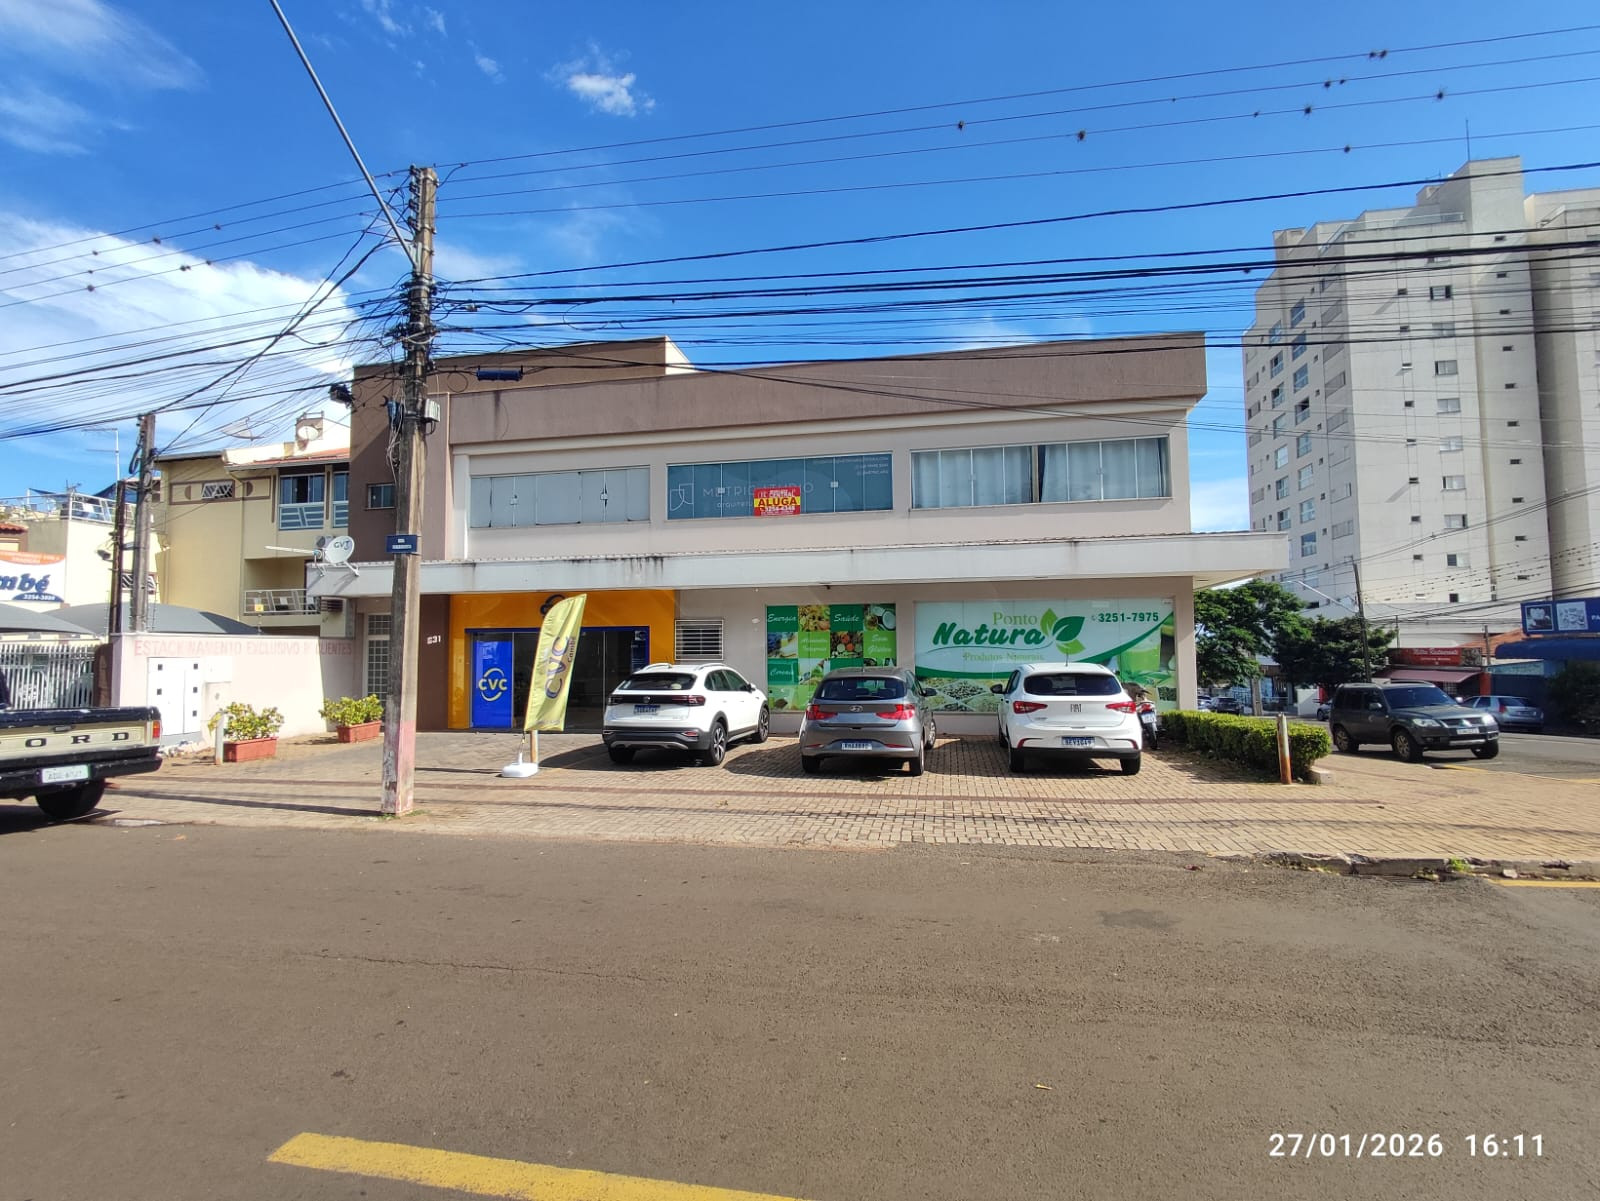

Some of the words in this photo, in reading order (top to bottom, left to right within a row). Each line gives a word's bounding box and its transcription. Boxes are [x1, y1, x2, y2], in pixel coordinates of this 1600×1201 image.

[757, 497, 798, 507] ALUGA
[767, 613, 797, 623] Energia
[833, 613, 860, 622] Saúde
[992, 611, 1038, 626] Ponto
[1098, 612, 1160, 623] 3251-7975
[932, 622, 1046, 646] Natura
[544, 636, 570, 699] CVC
[478, 678, 508, 691] CVC
[1070, 703, 1083, 713] FIAT
[0, 731, 129, 748] ORD
